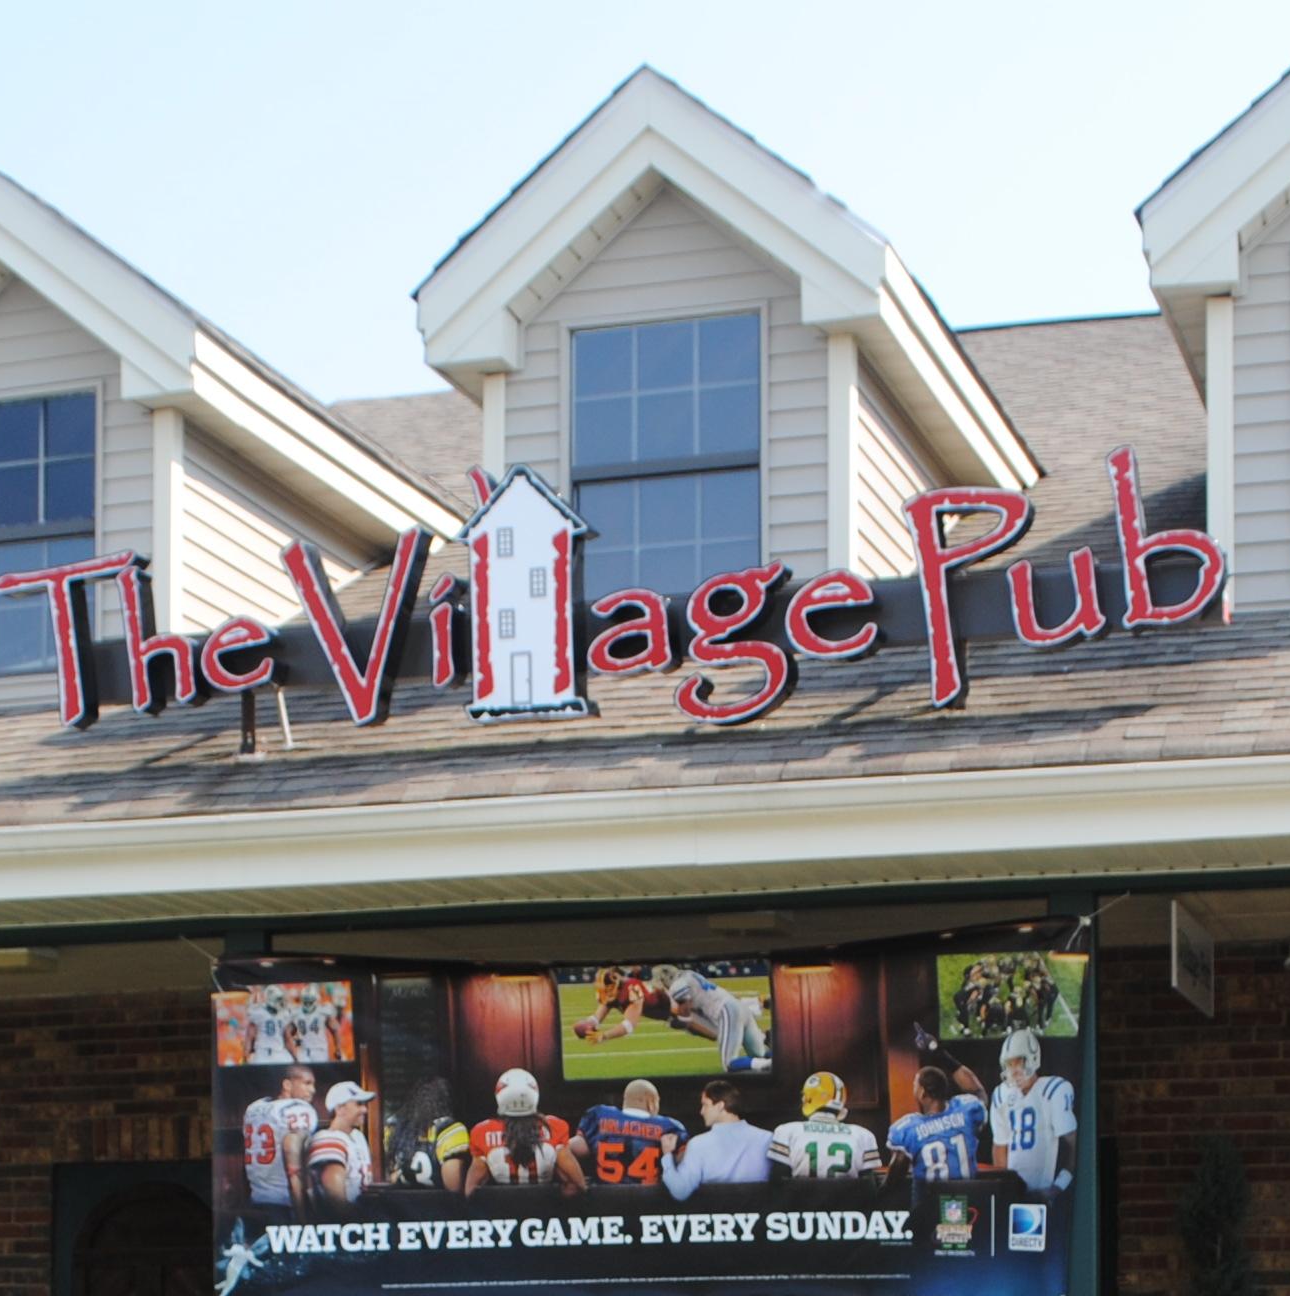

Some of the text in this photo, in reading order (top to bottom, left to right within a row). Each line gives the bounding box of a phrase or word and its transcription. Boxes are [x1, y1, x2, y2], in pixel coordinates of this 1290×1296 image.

[281, 463, 880, 726] Village
[905, 444, 1228, 709] Pub
[598, 1117, 663, 1141] URLACHER
[915, 1111, 966, 1141] JOHNSON
[1007, 1106, 1037, 1151] 18
[596, 1141, 660, 1185] 54
[804, 1140, 854, 1178] 12
[919, 1132, 971, 1180] 81
[265, 1210, 914, 1254] WATCH EVERY GAME. EVERY SUNDAY.
[1011, 1237, 1043, 1248] DIRECTV
